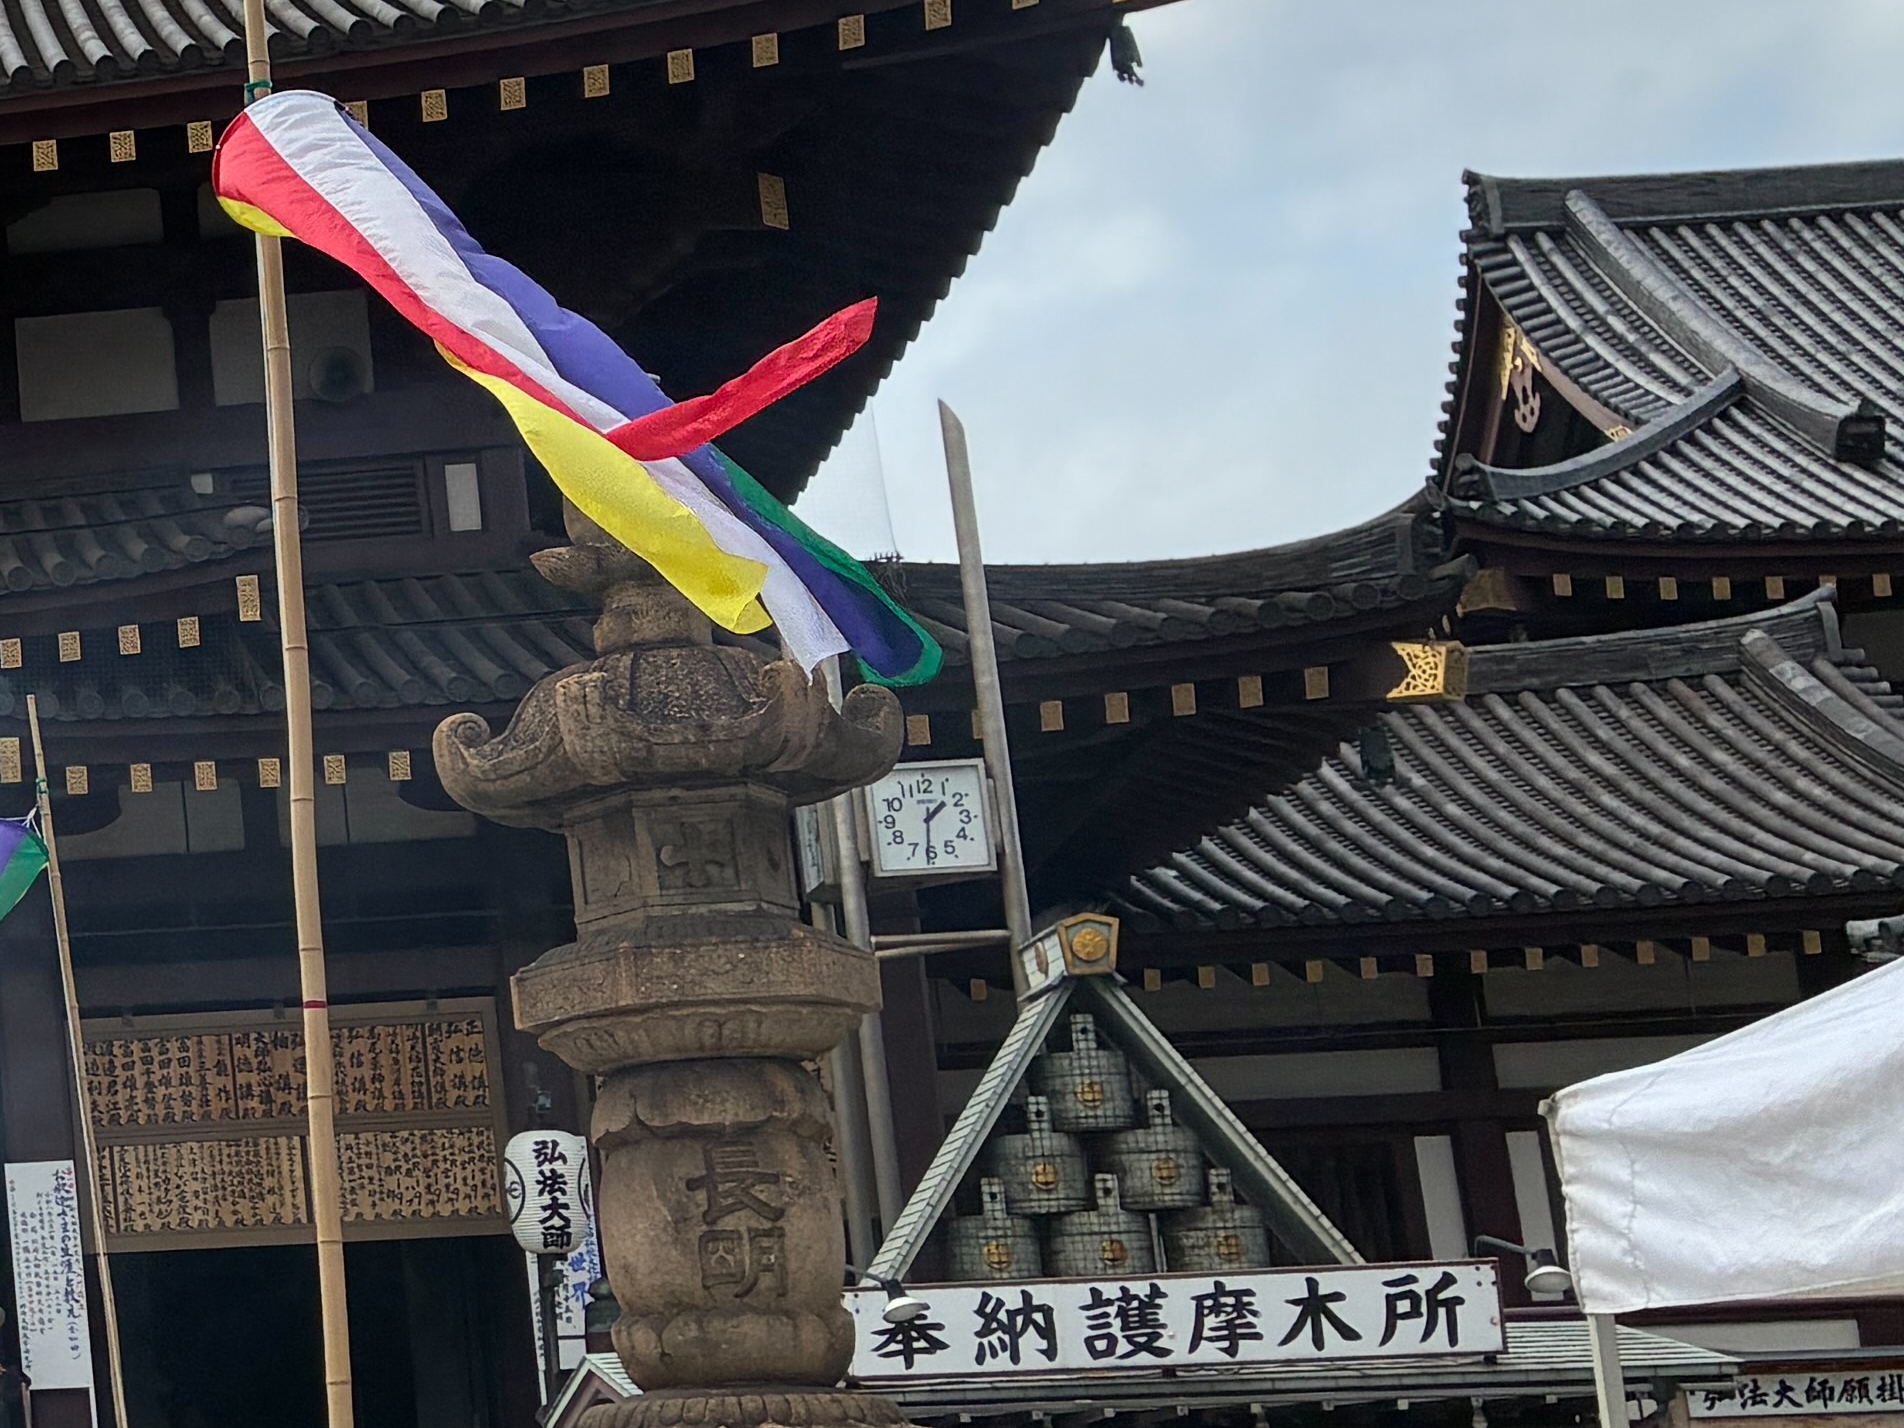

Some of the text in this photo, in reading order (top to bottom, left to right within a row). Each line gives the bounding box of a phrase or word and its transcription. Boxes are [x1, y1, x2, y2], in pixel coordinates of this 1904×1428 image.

[900, 783, 913, 798] 11
[917, 779, 933, 794] 12
[883, 797, 903, 812] 10
[952, 792, 964, 807] 2
[884, 815, 895, 829] 9
[959, 809, 972, 824] 3
[892, 830, 904, 844] 8
[956, 827, 968, 841] 4
[908, 843, 919, 857] 7
[926, 845, 937, 860] 6
[944, 840, 956, 854] 5
[532, 1139, 571, 1250] 弘法大師
[870, 1272, 1466, 1371] 奉納護摩木所
